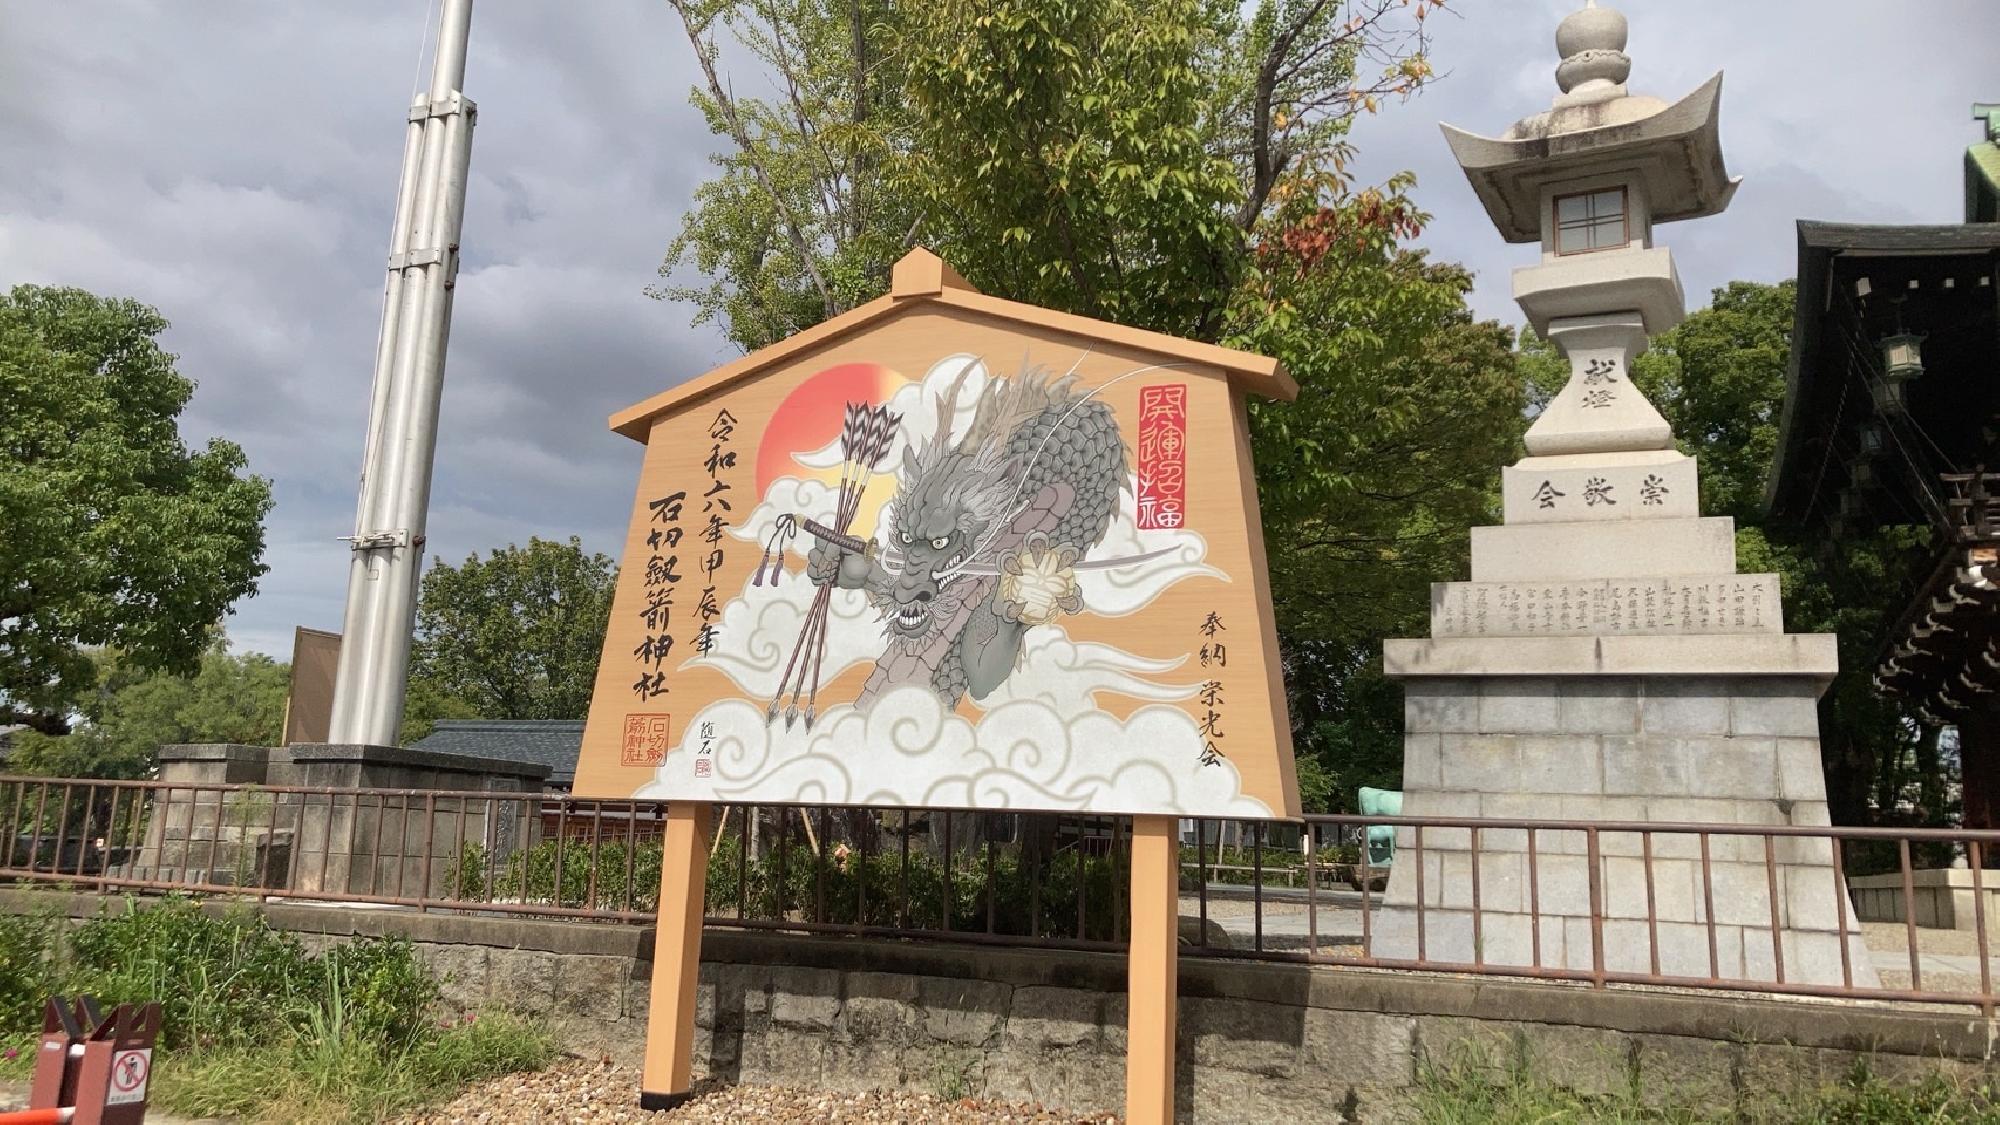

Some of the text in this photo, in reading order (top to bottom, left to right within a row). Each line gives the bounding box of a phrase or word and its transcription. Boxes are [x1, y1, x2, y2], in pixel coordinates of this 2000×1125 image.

[1532, 474, 1669, 508] 崇敬会
[689, 407, 738, 658] 令和六年甲辰年
[1199, 610, 1227, 669] 奉納
